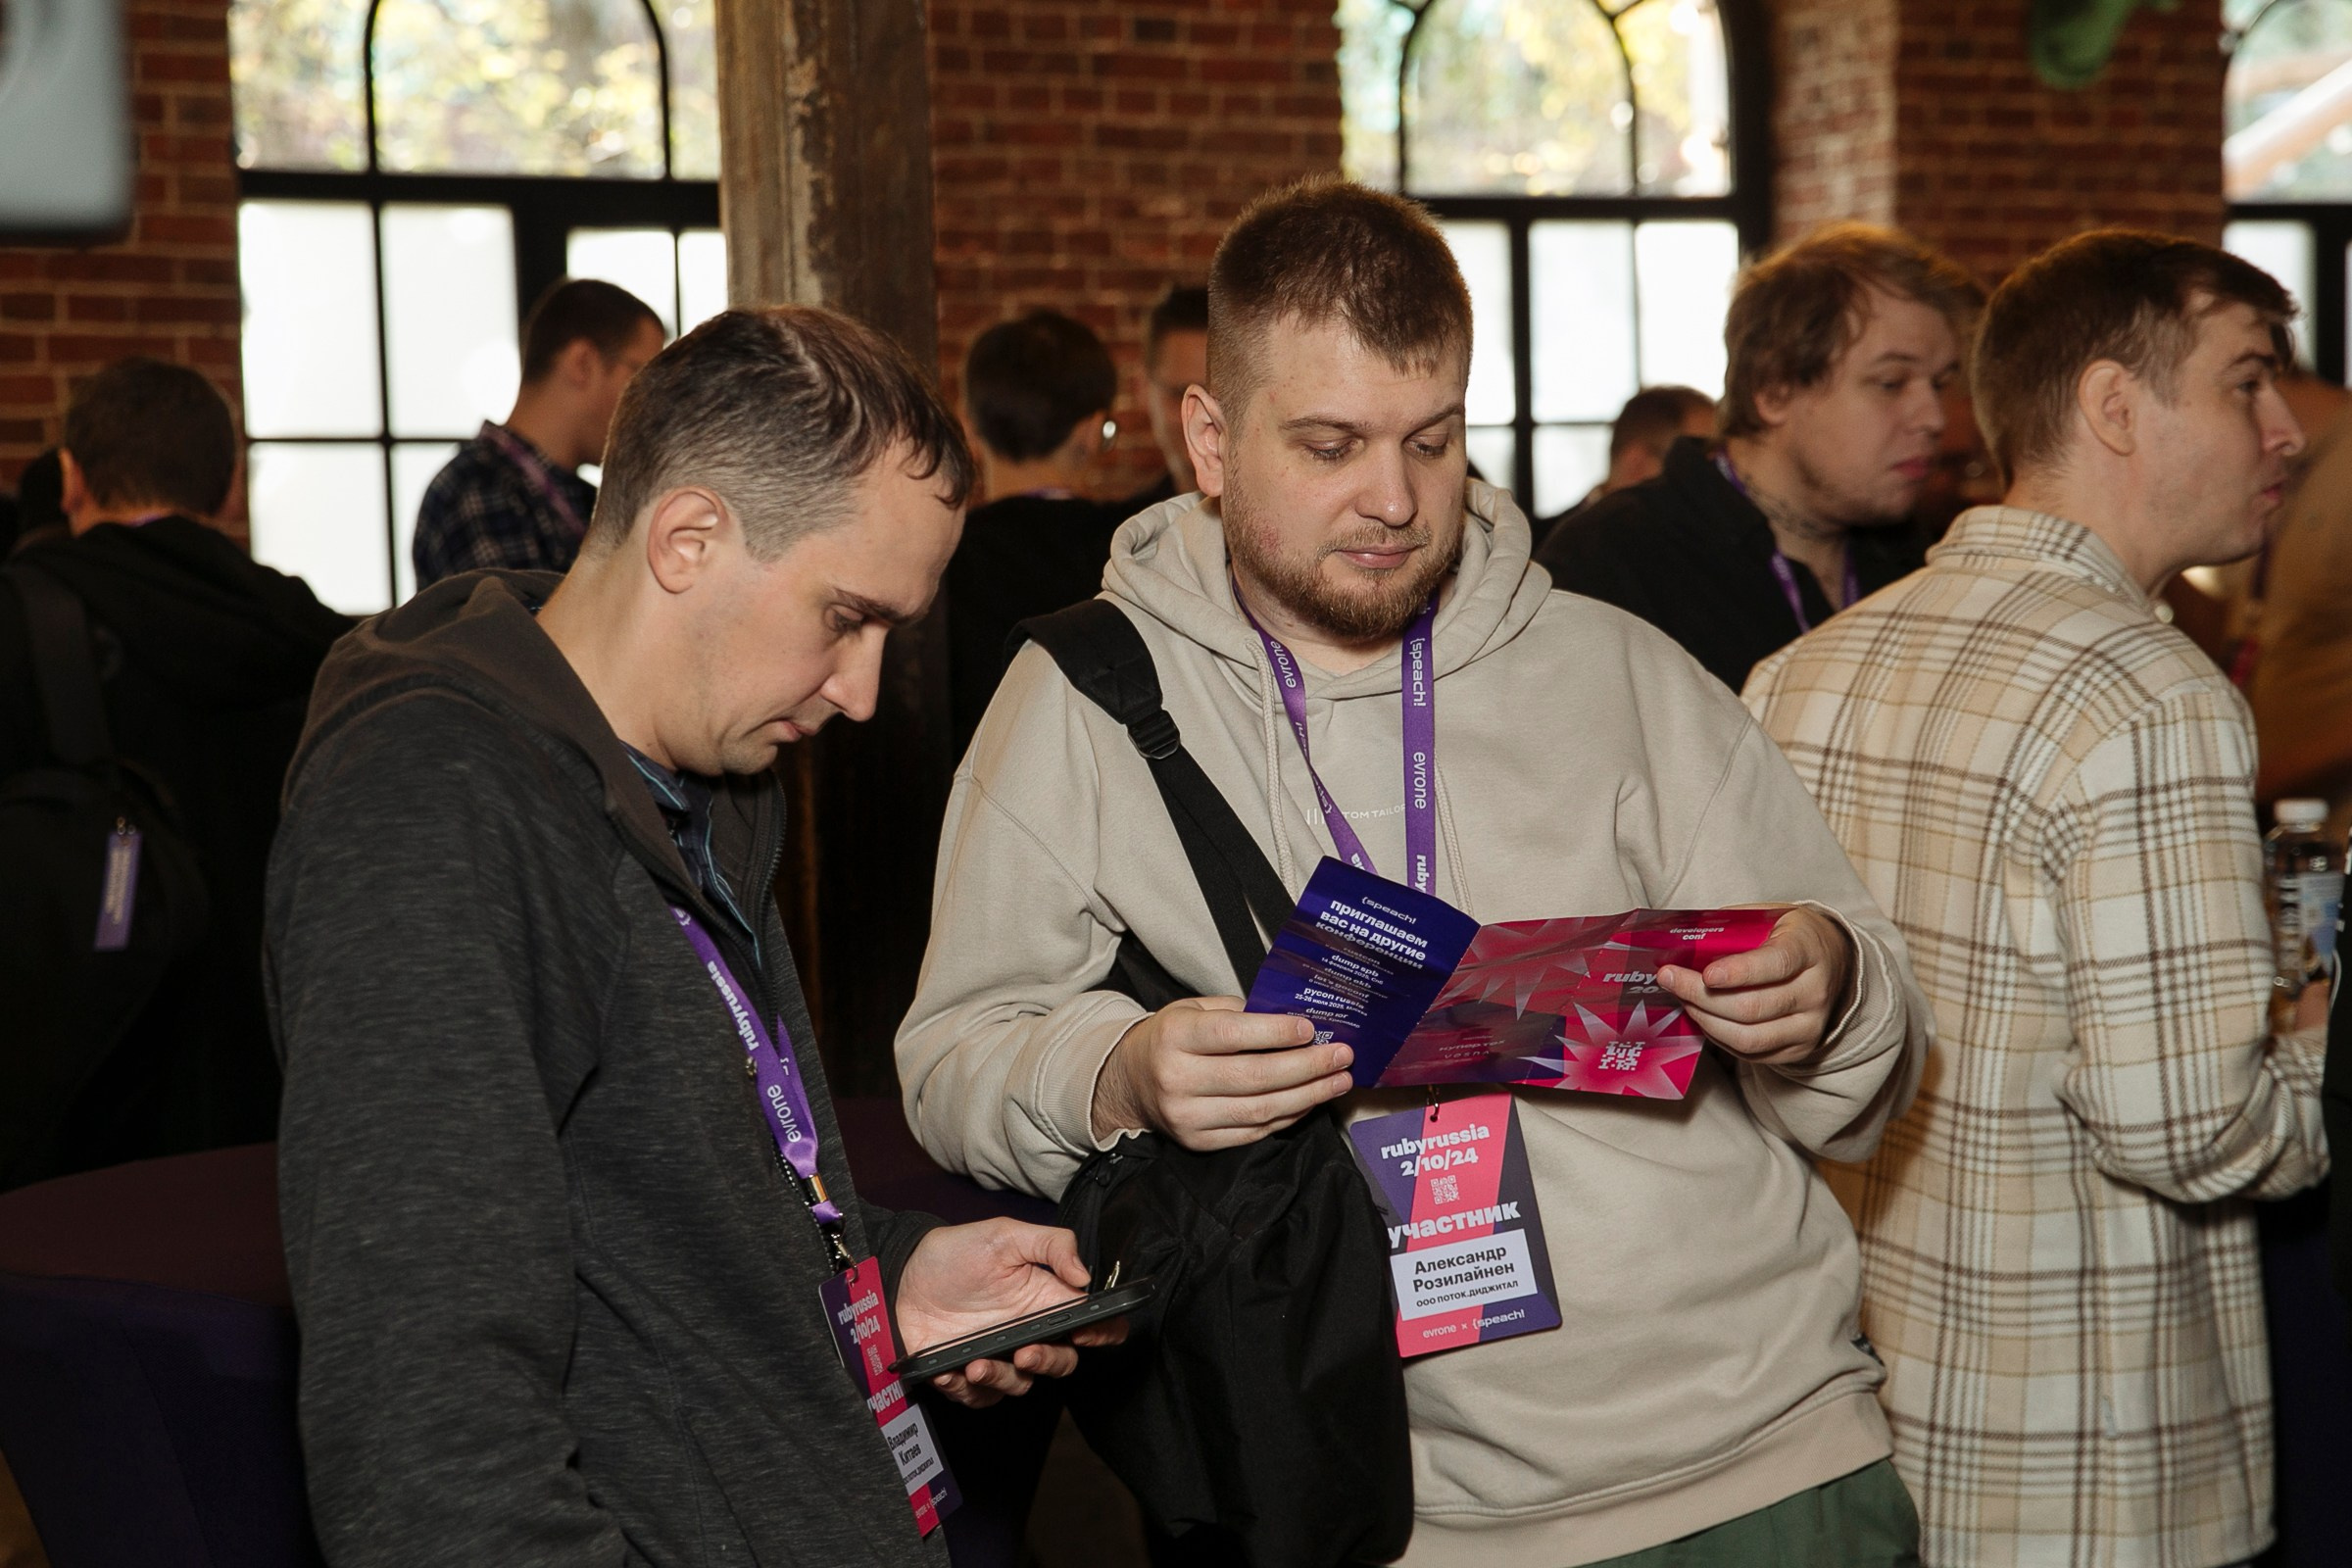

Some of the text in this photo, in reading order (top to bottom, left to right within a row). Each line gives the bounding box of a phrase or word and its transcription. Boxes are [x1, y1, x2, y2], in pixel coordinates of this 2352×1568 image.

[1270, 640, 1297, 688] evrone
[1413, 752, 1427, 809] evrone
[1342, 810, 1369, 819] TOM
[1320, 911, 1426, 960] вас на другие
[1330, 900, 1428, 948] приглашаем
[1669, 926, 1725, 935] developers
[1315, 921, 1423, 970] конференции
[1324, 967, 1372, 989] dump ekb
[1331, 955, 1379, 977] dump spb
[707, 960, 760, 1052] rubyrussia
[1303, 987, 1364, 1009] pycon russia
[1305, 1007, 1334, 1017] dump
[766, 1084, 802, 1143] evrone
[1381, 1123, 1490, 1159] rubyrussia
[1400, 1148, 1479, 1177] 2/10/24
[1388, 1201, 1521, 1250] участник
[1414, 1247, 1506, 1275] Александр
[1413, 1263, 1515, 1293] Розилайнен
[837, 1289, 879, 1325] rubyrussia
[850, 1315, 881, 1346] 2/10/24
[1423, 1324, 1457, 1339] evrone
[866, 1379, 905, 1413] частн
[887, 1422, 919, 1450] Владимир
[898, 1444, 921, 1466] Китаев
